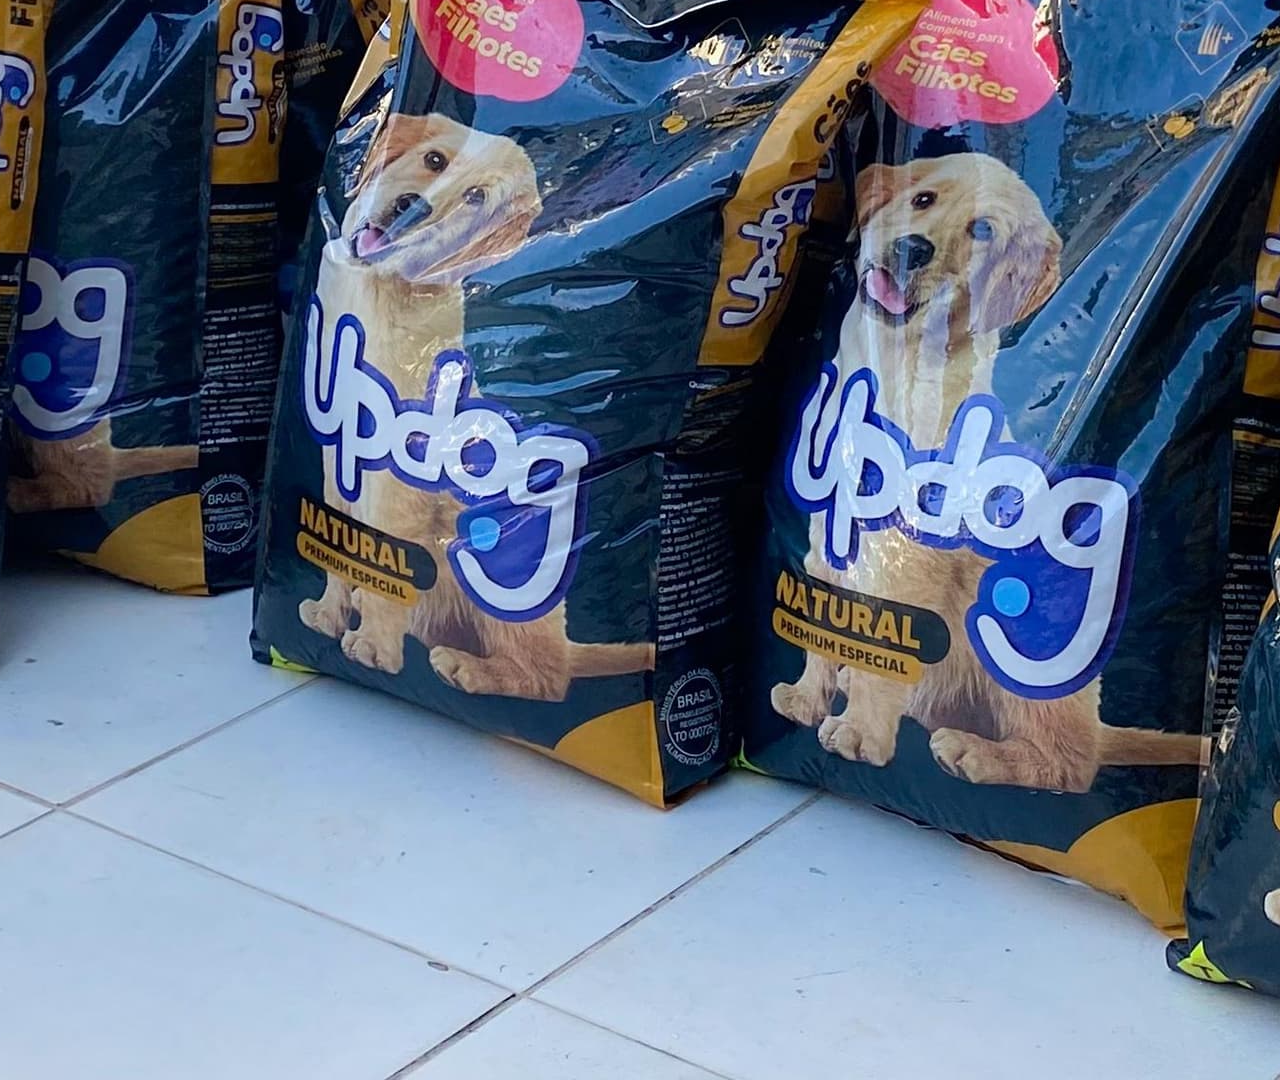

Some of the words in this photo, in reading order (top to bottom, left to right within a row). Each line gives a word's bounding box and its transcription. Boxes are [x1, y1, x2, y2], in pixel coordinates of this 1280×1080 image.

[919, 21, 975, 39] completo
[976, 32, 1005, 45] para
[924, 9, 977, 28] Alimento
[216, 3, 284, 144] Updog
[895, 54, 1019, 103] Filhotes
[910, 34, 988, 67] Cães
[721, 178, 817, 327] Updog
[307, 302, 593, 614] Updog
[207, 491, 245, 505] BRASIL
[300, 497, 414, 577] NATURAL
[791, 370, 1132, 690] Updog
[304, 541, 349, 576] PREMIUM
[351, 566, 407, 600] ESPECIAL
[776, 570, 920, 650] NATURAL
[781, 617, 835, 654] PREMIUM
[839, 642, 908, 675] ESPECIAL
[677, 688, 713, 708] BRASIL
[674, 730, 687, 742] TO
